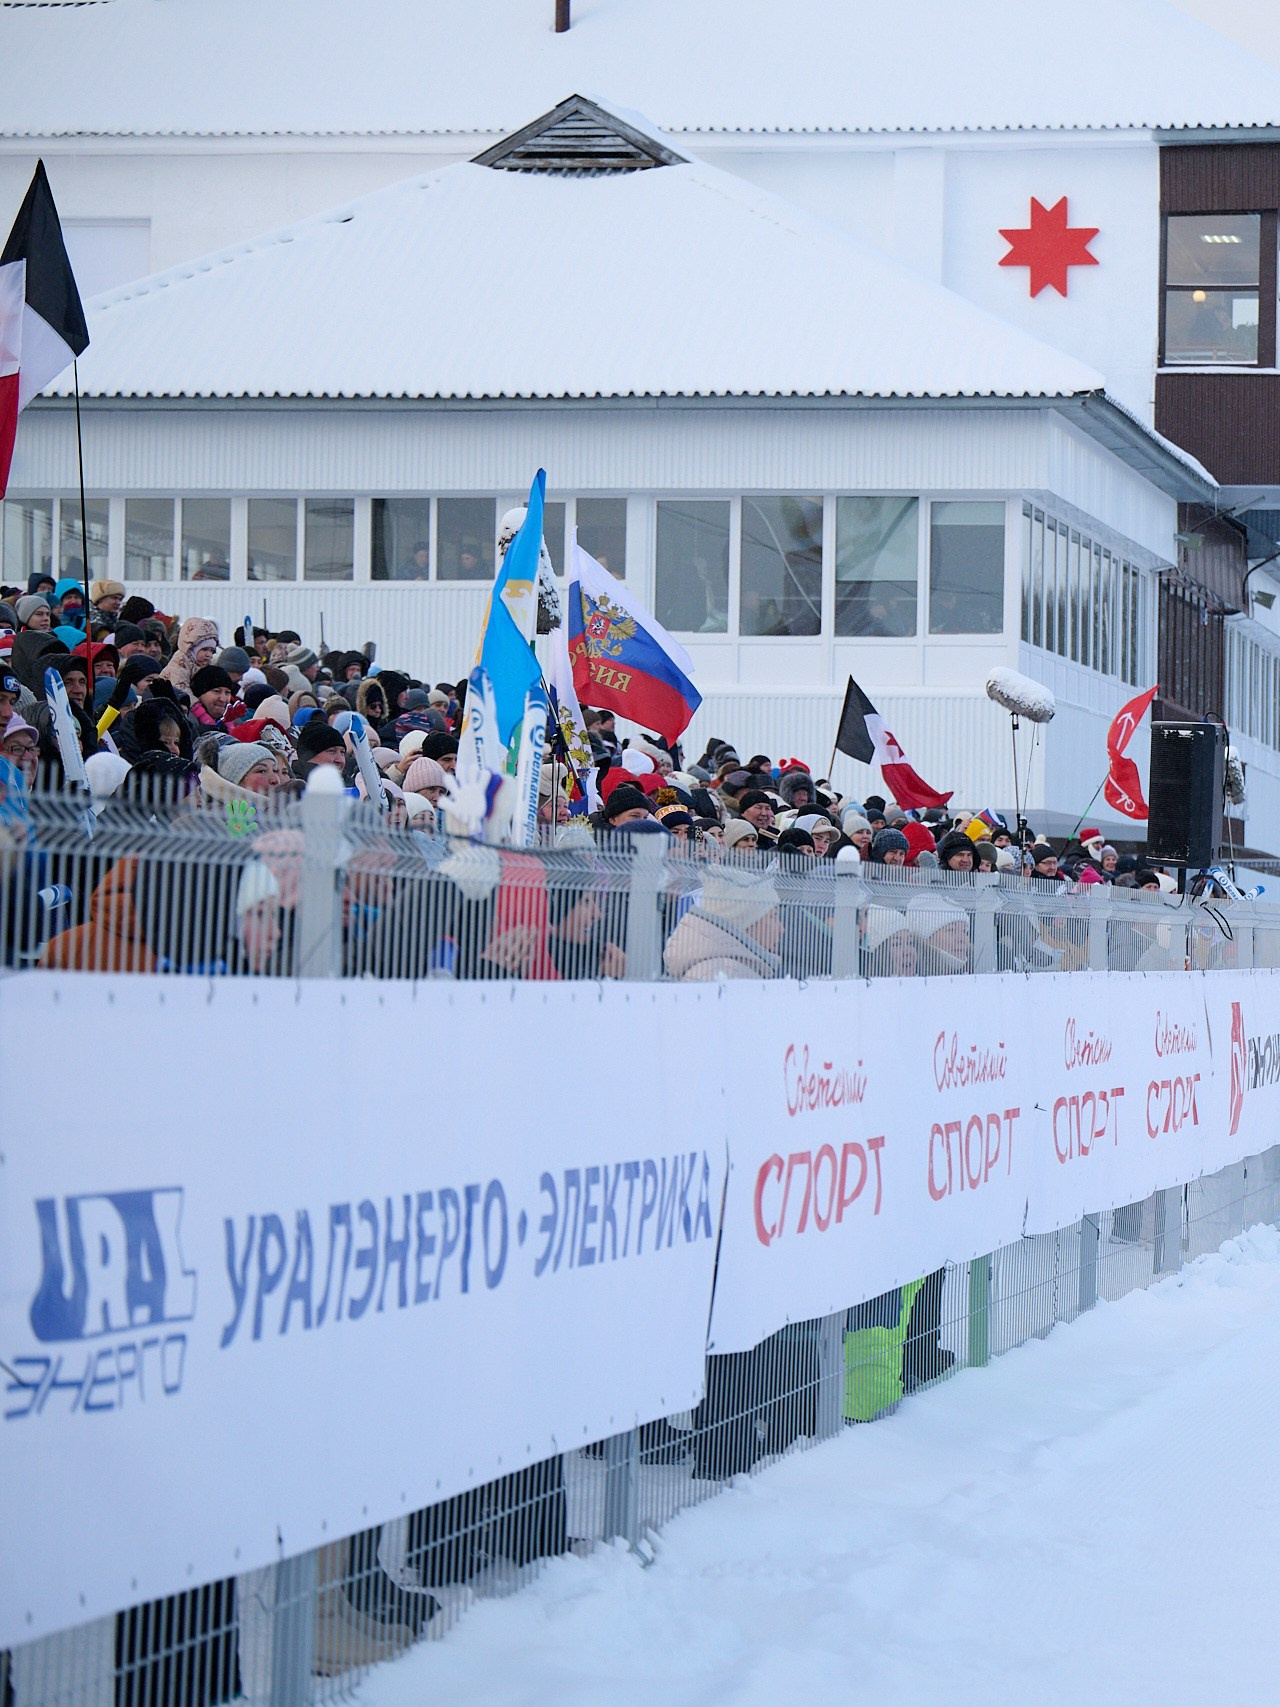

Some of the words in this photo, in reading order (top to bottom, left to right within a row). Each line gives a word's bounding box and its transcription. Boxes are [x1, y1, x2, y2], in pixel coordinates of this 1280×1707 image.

[927, 1107, 1021, 1201] СПОРТ
[1052, 1087, 1126, 1164] СПОРТ
[753, 1136, 886, 1247] СПОРТ
[219, 1178, 508, 1350] УРАЛЭНЕРГО
[534, 1149, 713, 1278] ЭЛЕКТРИКА
[3, 1333, 188, 1421] ЭНЕРГО
